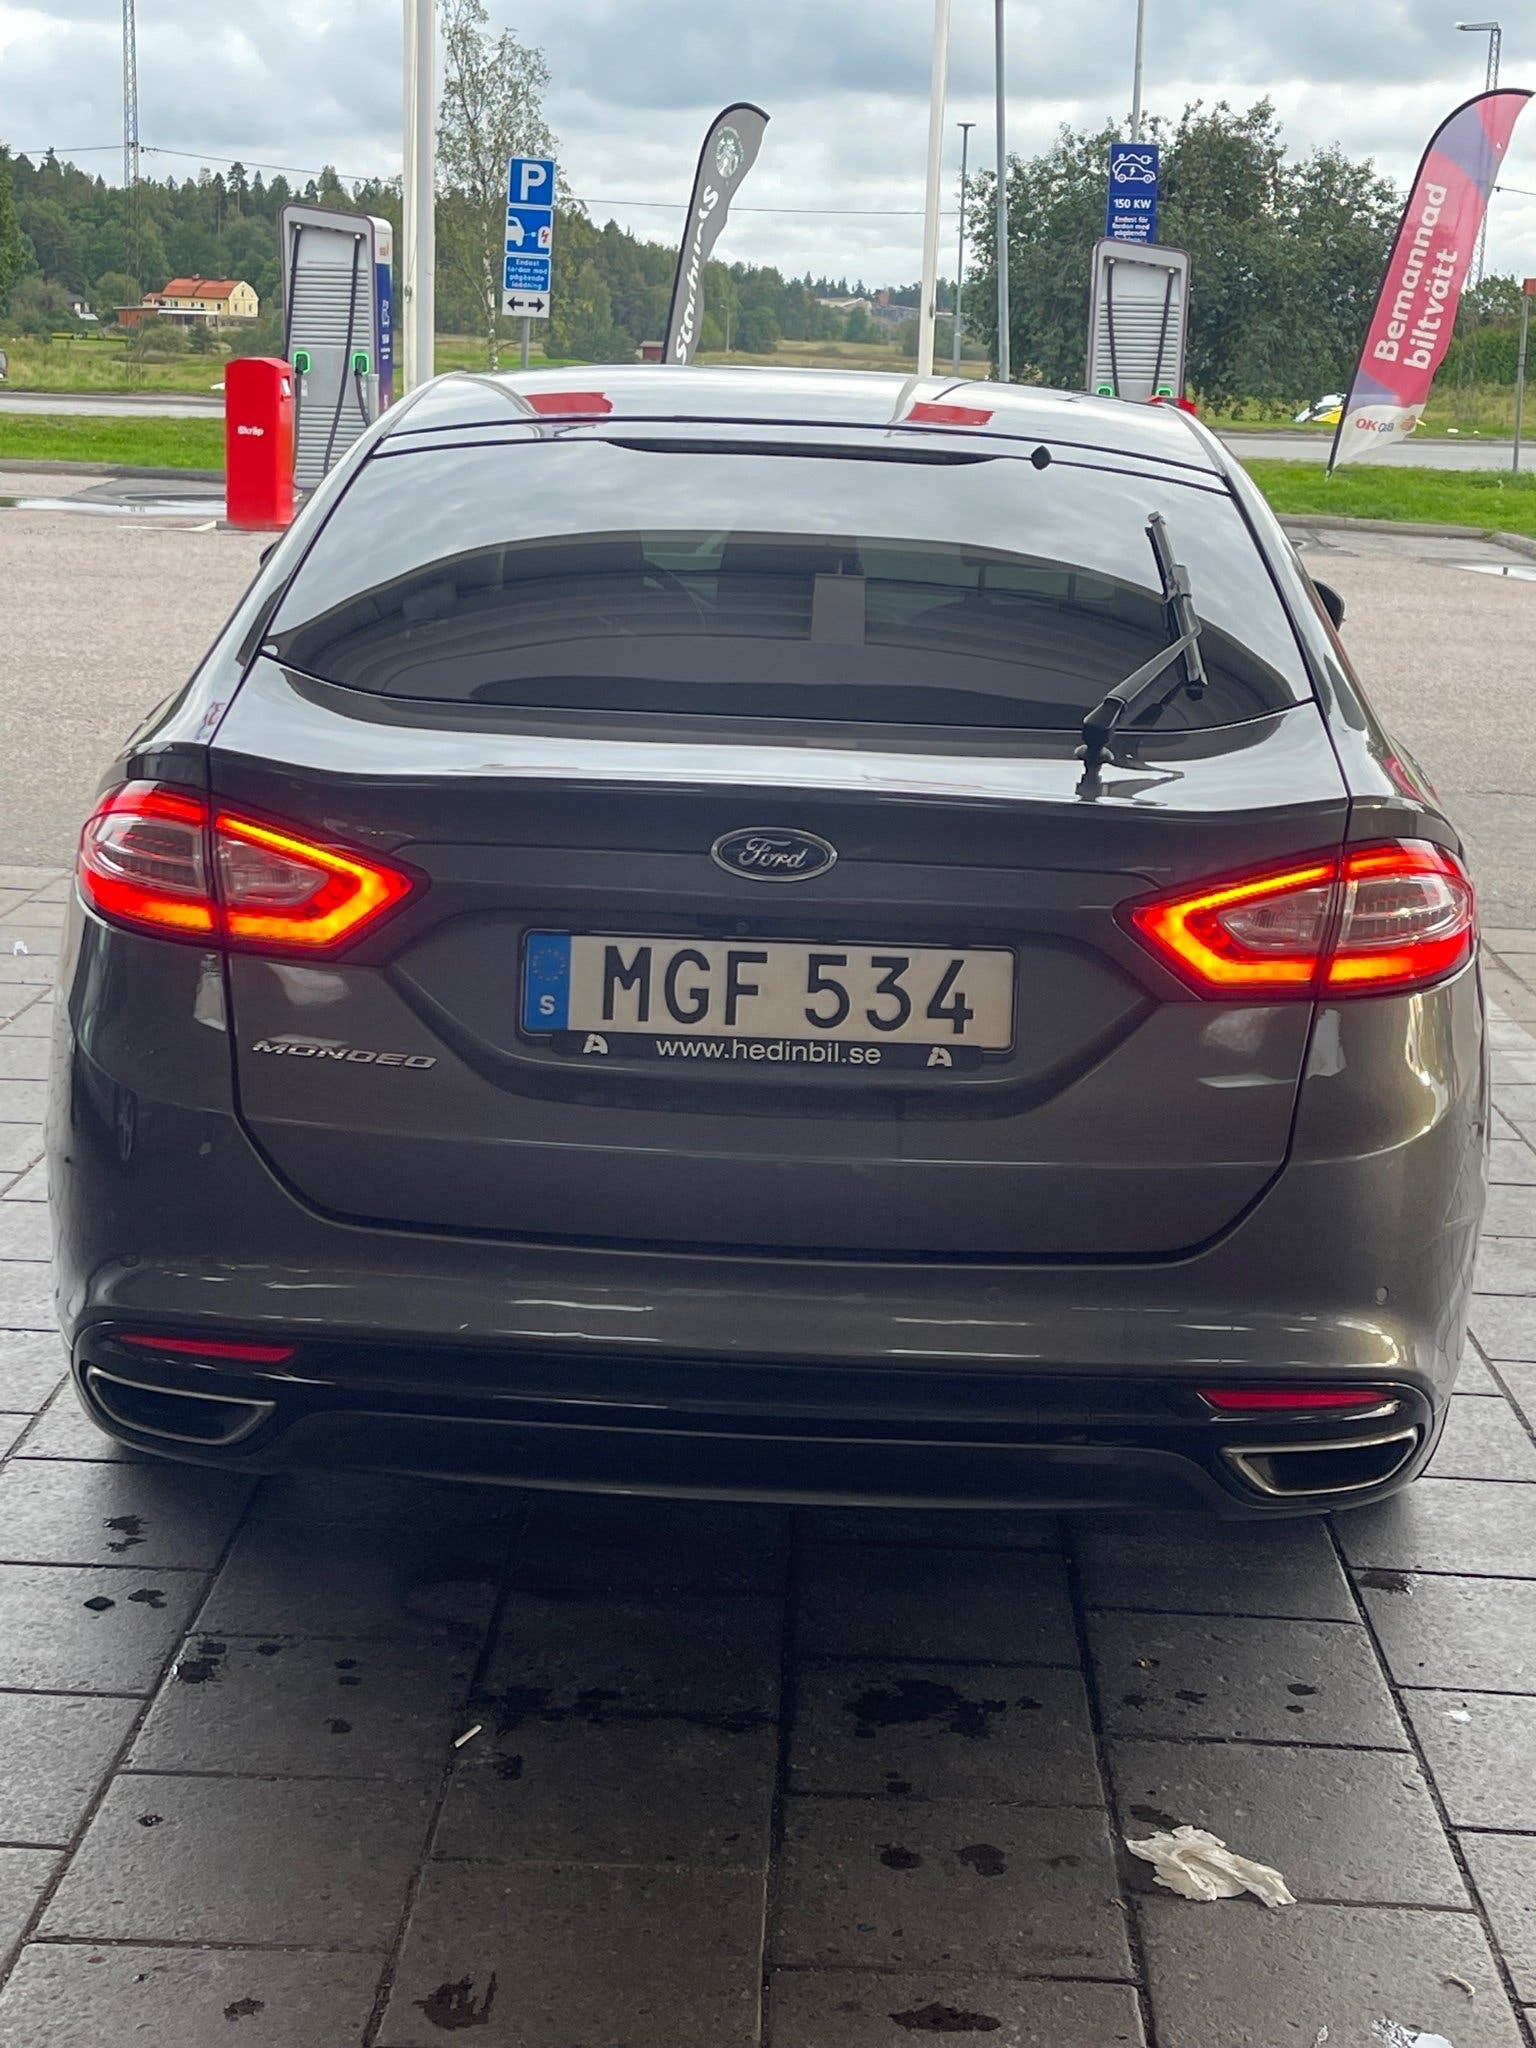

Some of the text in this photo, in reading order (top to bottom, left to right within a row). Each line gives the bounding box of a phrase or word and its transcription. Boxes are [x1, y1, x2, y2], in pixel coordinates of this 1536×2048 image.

[520, 163, 547, 200] P
[1114, 198, 1151, 209] 150 KW
[1373, 182, 1448, 361] Bemannad
[1403, 248, 1458, 369] biltvätt
[739, 837, 808, 868] Ford
[539, 994, 555, 1015] S
[602, 945, 974, 1035] MGF 534
[252, 1039, 437, 1069] MONDEO
[656, 1038, 882, 1065] www.hedinbil.se
